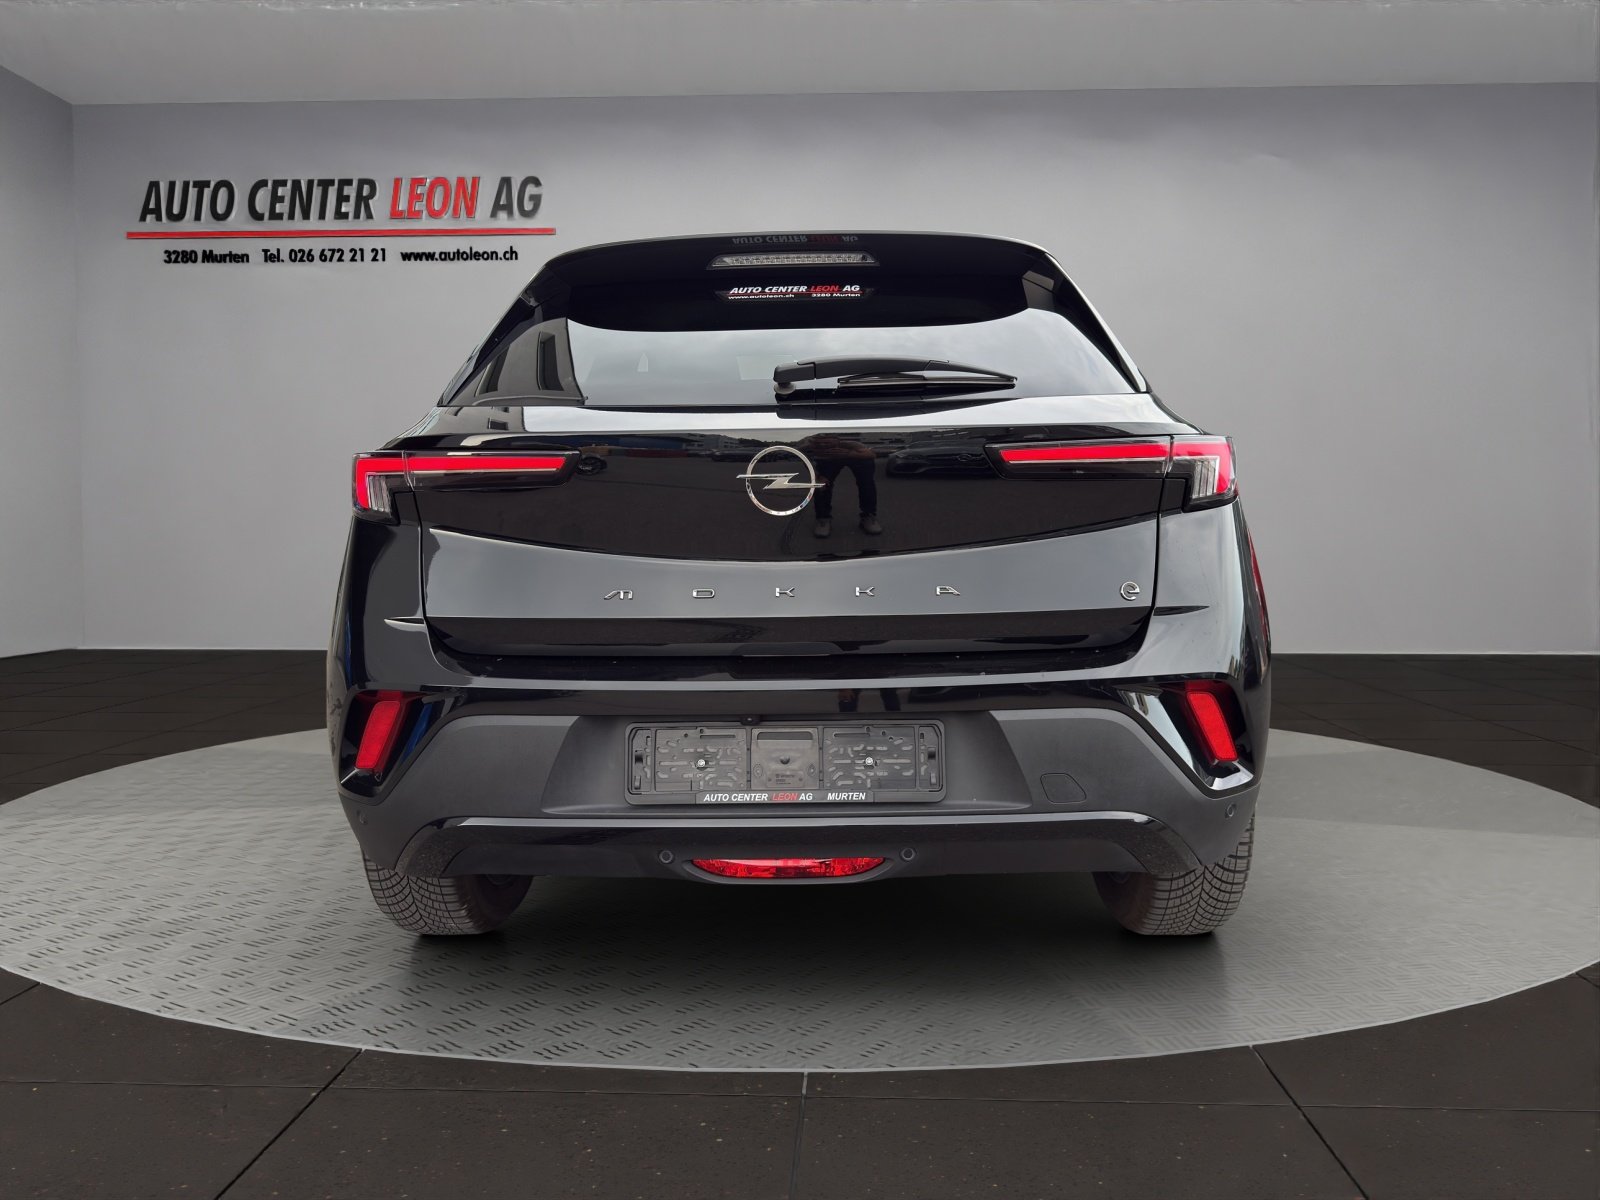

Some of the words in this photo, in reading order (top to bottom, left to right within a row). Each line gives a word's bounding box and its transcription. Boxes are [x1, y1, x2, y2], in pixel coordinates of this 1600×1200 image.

[139, 180, 234, 222] AUTO
[247, 179, 377, 221] CENTER
[389, 176, 480, 219] LEON
[490, 175, 542, 220] AG
[163, 250, 198, 264] 3280
[201, 249, 249, 264] Murten
[262, 249, 284, 263] Tel.
[288, 249, 315, 263] 026
[319, 248, 345, 262] 672
[348, 248, 365, 262] 21
[370, 248, 386, 262] 21
[401, 246, 518, 263] www.autoleon.ch
[729, 286, 762, 294] AUTO
[603, 587, 961, 600] MOKKA
[703, 794, 729, 802] AUTO
[731, 793, 768, 802] CENTER
[772, 792, 797, 801] LEON
[799, 792, 813, 801] AG
[827, 792, 866, 801] MURTEN
